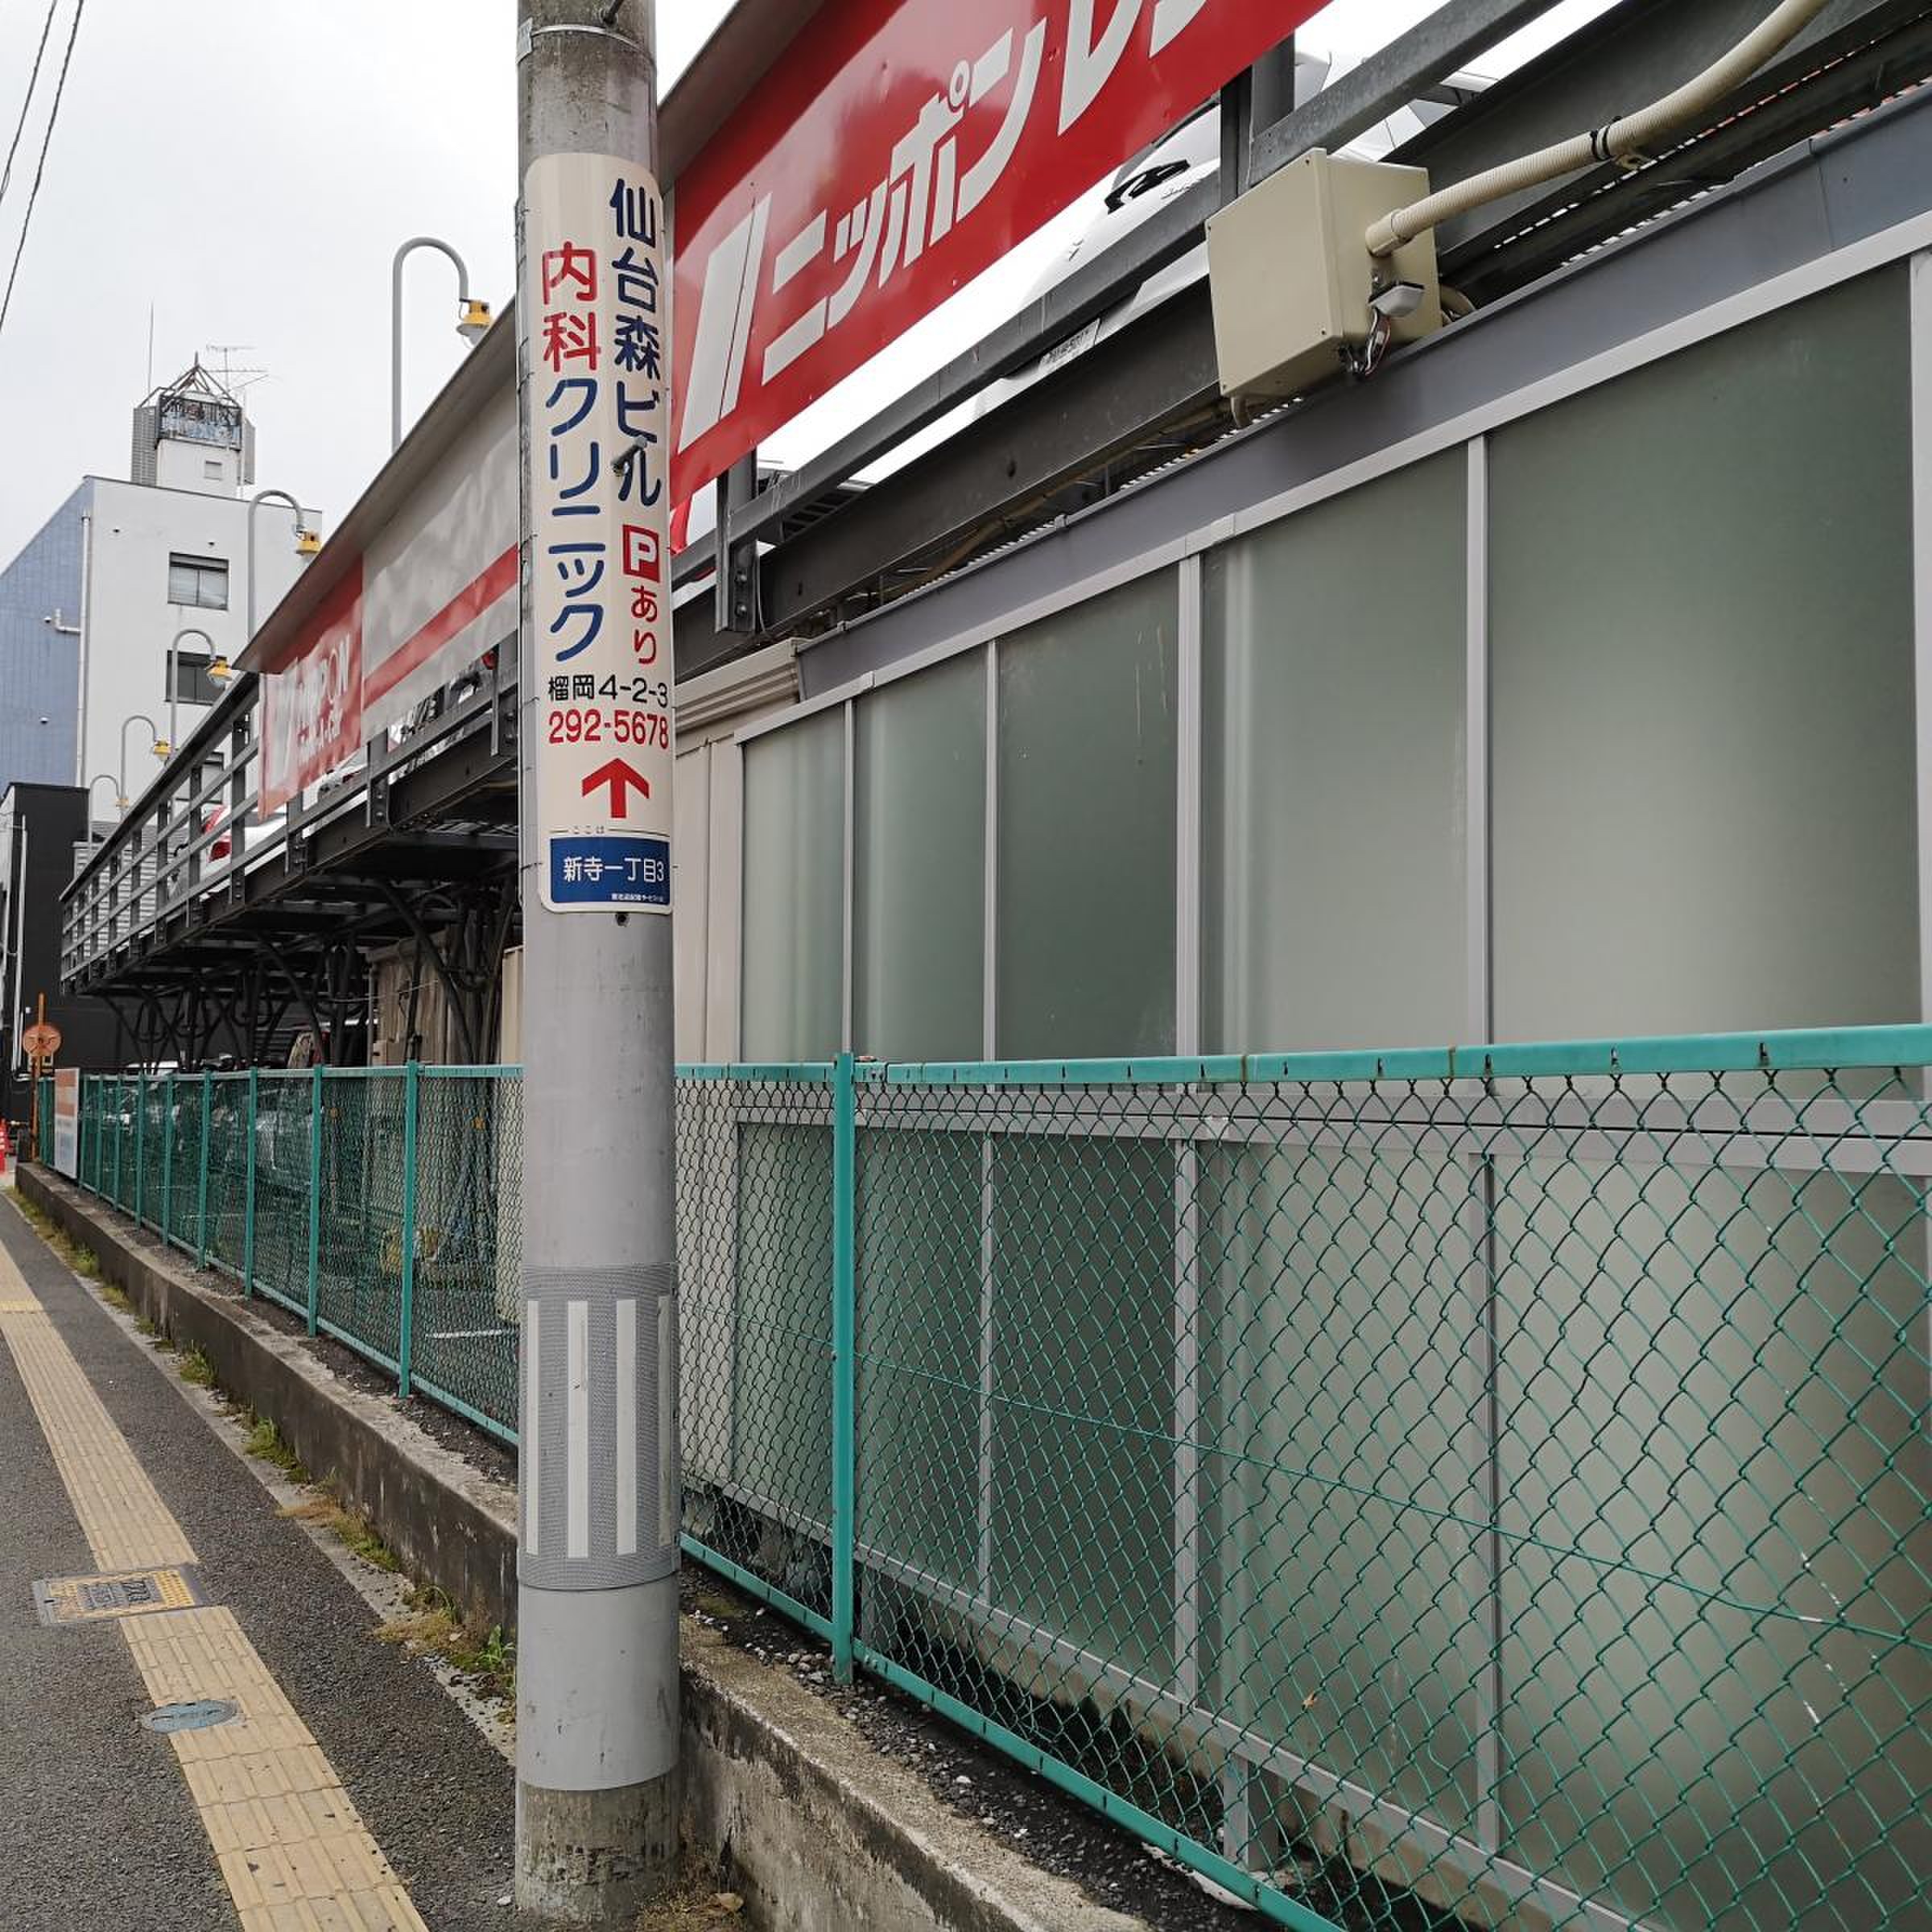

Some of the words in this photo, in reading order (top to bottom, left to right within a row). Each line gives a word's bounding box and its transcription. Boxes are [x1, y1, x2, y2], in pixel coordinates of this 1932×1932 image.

[609, 178, 662, 506] 仙台森ビル
[762, 0, 1207, 386] ニッポンレ
[542, 242, 606, 663] 内科クリニック
[549, 708, 669, 749] 292-5678
[564, 856, 665, 883] 新寺一丁目3
